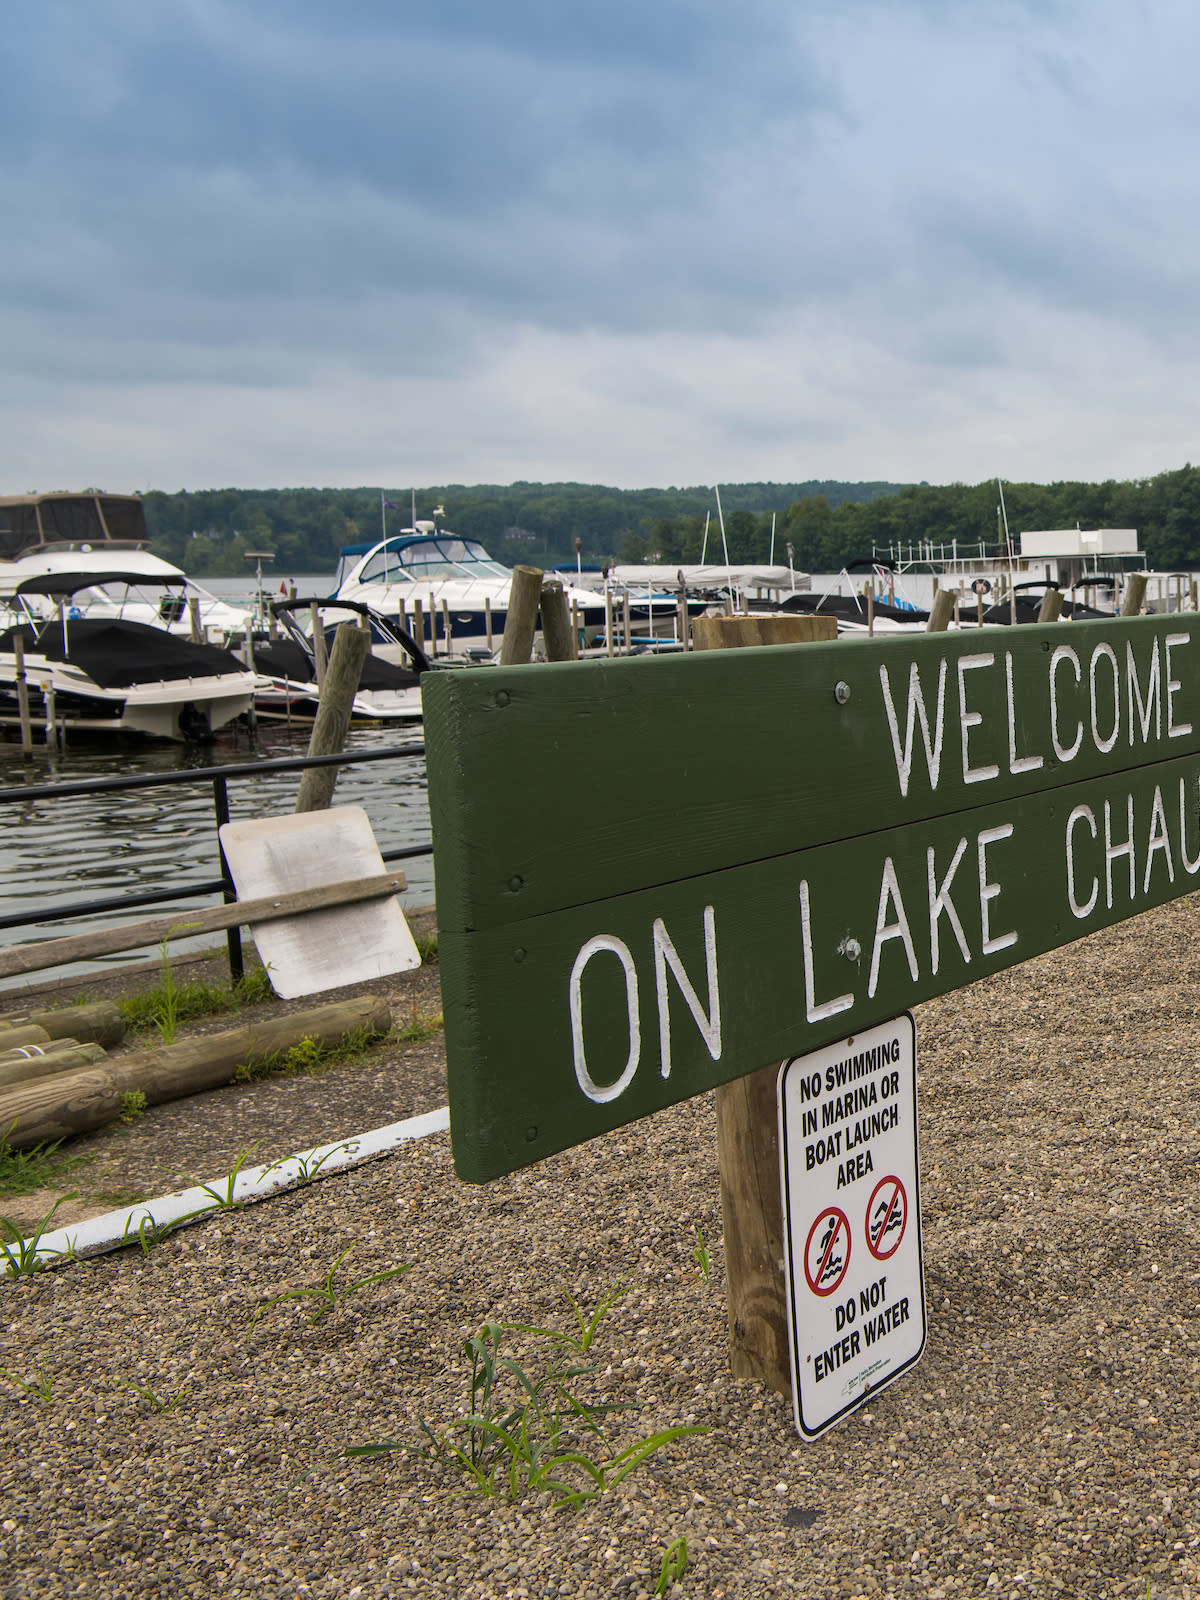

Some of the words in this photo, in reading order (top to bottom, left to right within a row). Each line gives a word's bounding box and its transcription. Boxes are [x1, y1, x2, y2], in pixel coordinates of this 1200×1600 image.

[879, 632, 1193, 797] WELCOME
[569, 905, 721, 1103] ON
[800, 822, 1018, 1023] LAKE
[800, 1072, 821, 1103] NO
[825, 1038, 899, 1091] SWIMMING
[802, 1108, 817, 1137] IN
[822, 1082, 877, 1128] MARINA
[881, 1071, 899, 1099] OR
[805, 1130, 841, 1170] BOAT
[845, 1103, 898, 1150] LAUNCH
[836, 1149, 873, 1189] AREA
[835, 1297, 855, 1332] DO
[860, 1276, 886, 1316] NOT
[814, 1330, 860, 1383] ENTER
[863, 1297, 909, 1347] WATER
